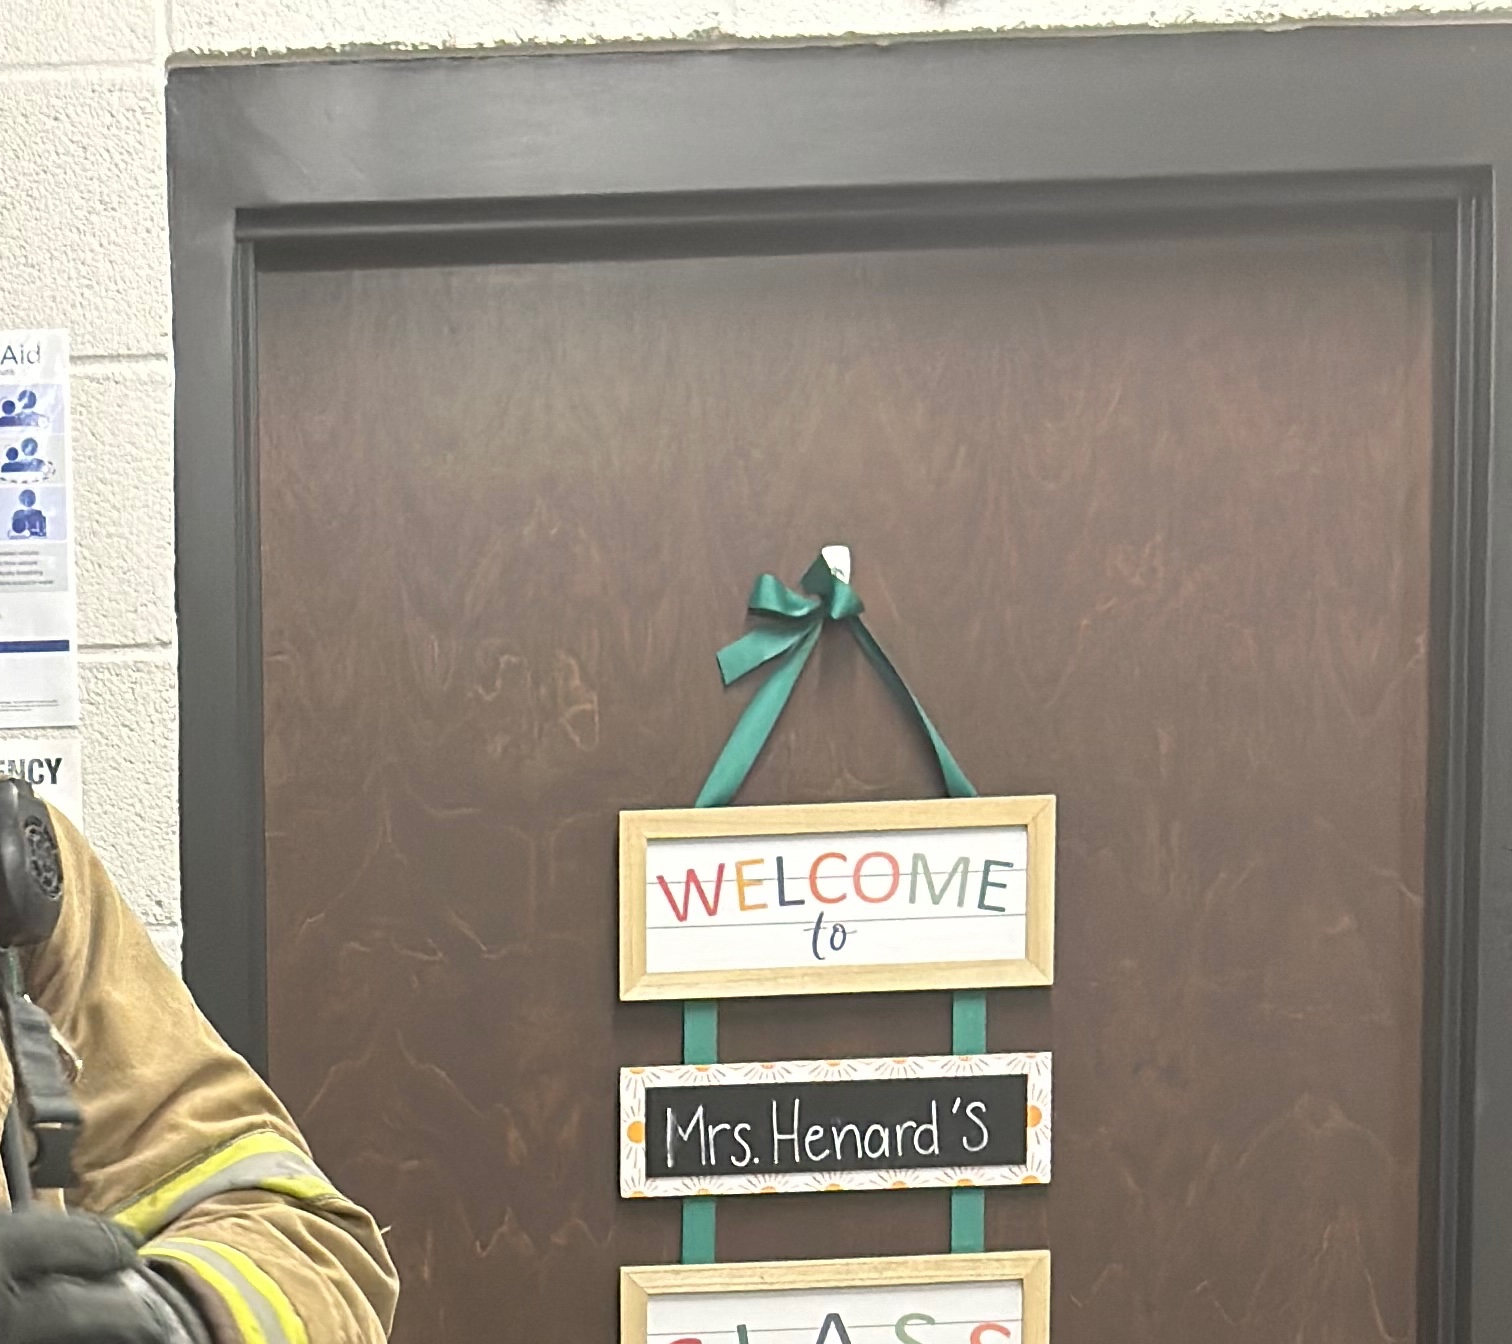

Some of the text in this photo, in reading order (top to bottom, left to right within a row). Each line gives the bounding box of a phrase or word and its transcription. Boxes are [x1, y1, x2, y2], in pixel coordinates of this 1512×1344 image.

[0, 341, 41, 365] Aid
[656, 851, 1014, 922] WELCOME
[803, 911, 857, 960] to
[666, 1104, 760, 1169] Mrs.
